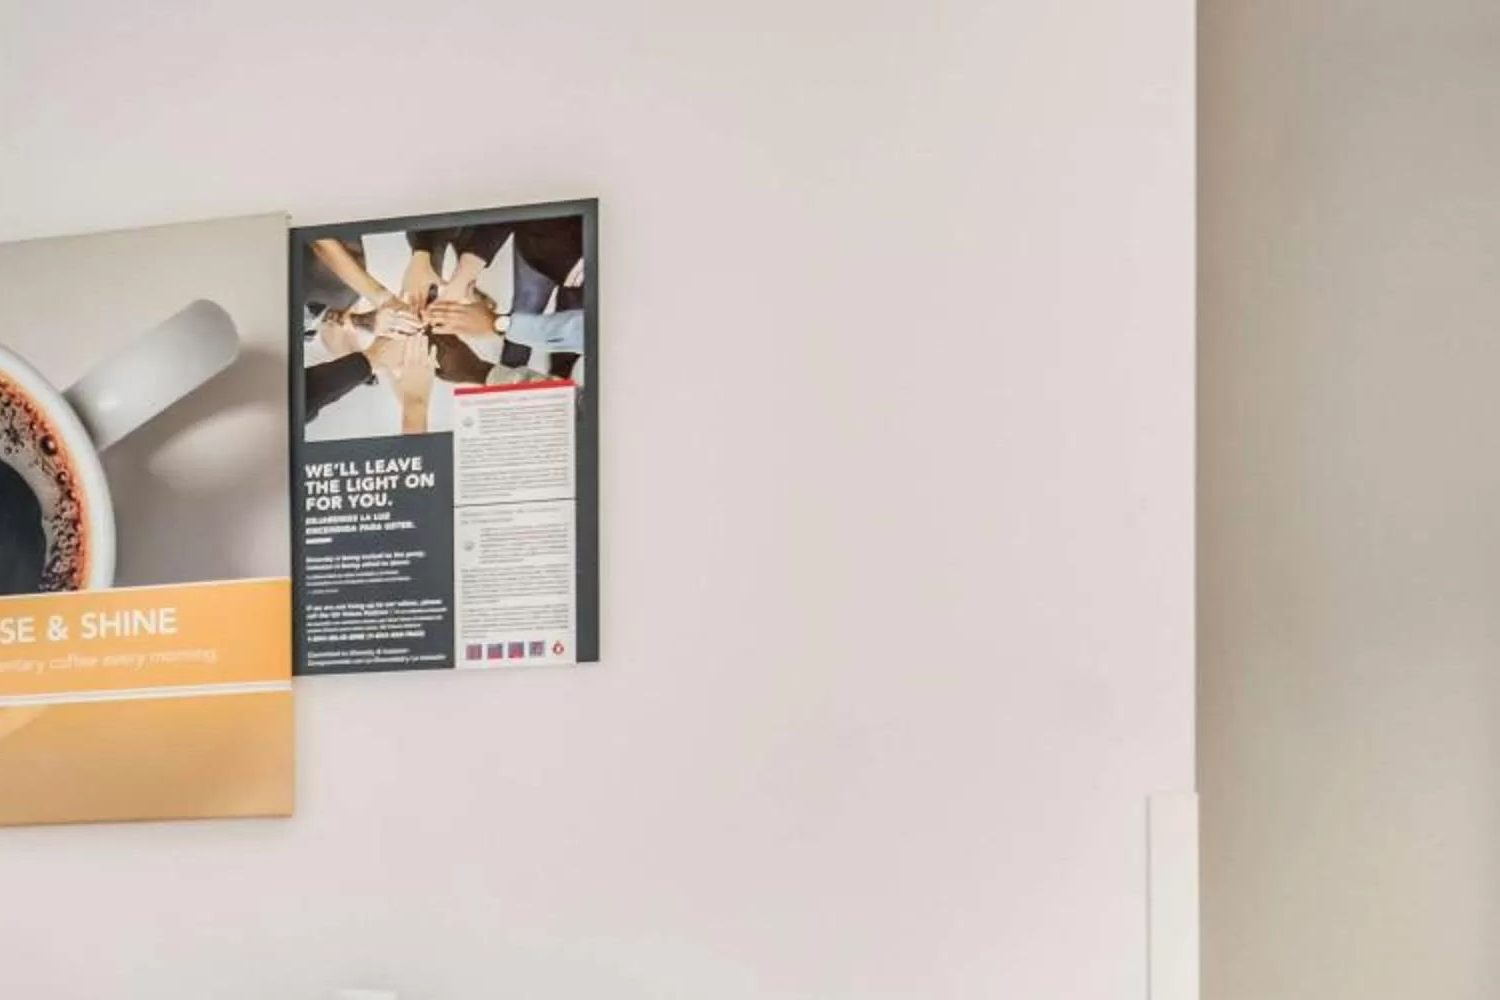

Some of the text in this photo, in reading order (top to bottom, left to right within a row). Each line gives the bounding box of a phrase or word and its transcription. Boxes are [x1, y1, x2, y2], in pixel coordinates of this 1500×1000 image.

[305, 456, 422, 478] WE'LL LEAVE
[305, 473, 435, 494] THE LIGHT ON
[305, 492, 393, 511] FOR YOU.
[47, 615, 68, 641] &
[80, 607, 178, 640] SHINE
[49, 652, 99, 670] coffee
[102, 653, 146, 672] every
